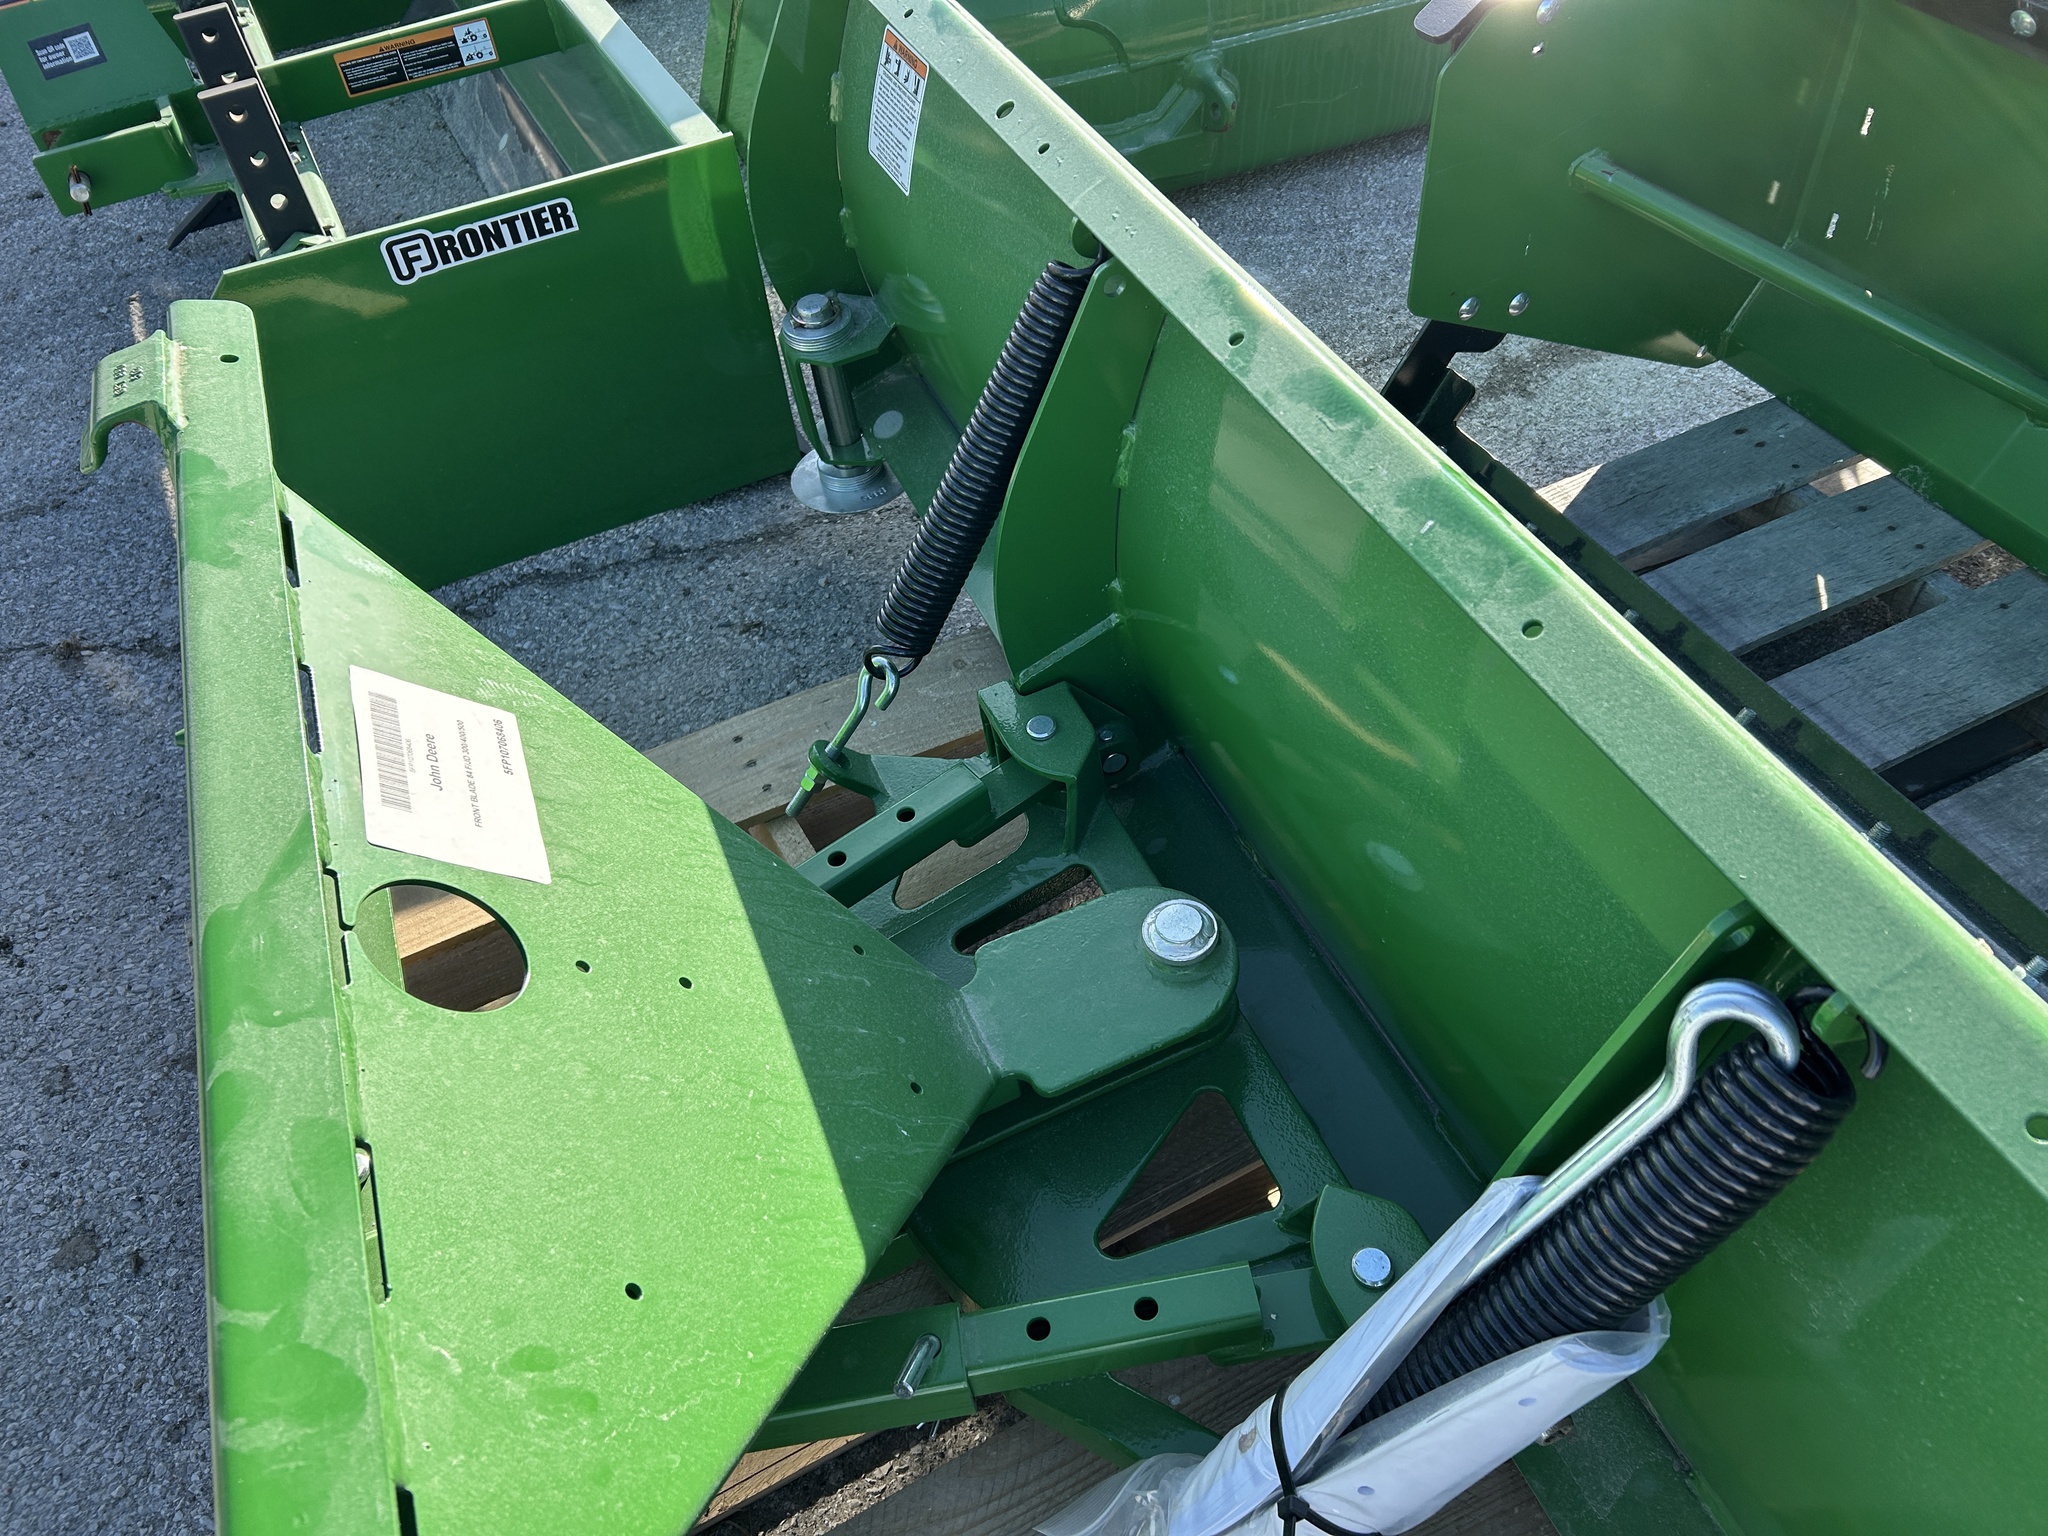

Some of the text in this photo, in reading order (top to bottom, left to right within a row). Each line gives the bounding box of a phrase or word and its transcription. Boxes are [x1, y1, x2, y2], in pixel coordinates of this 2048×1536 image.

[383, 39, 415, 50] WARNING
[898, 45, 917, 69] WARNING
[386, 201, 575, 281] FRONTIER
[425, 732, 443, 791] John Deere
[467, 779, 478, 802] BLADE
[471, 803, 482, 828] FRONT
